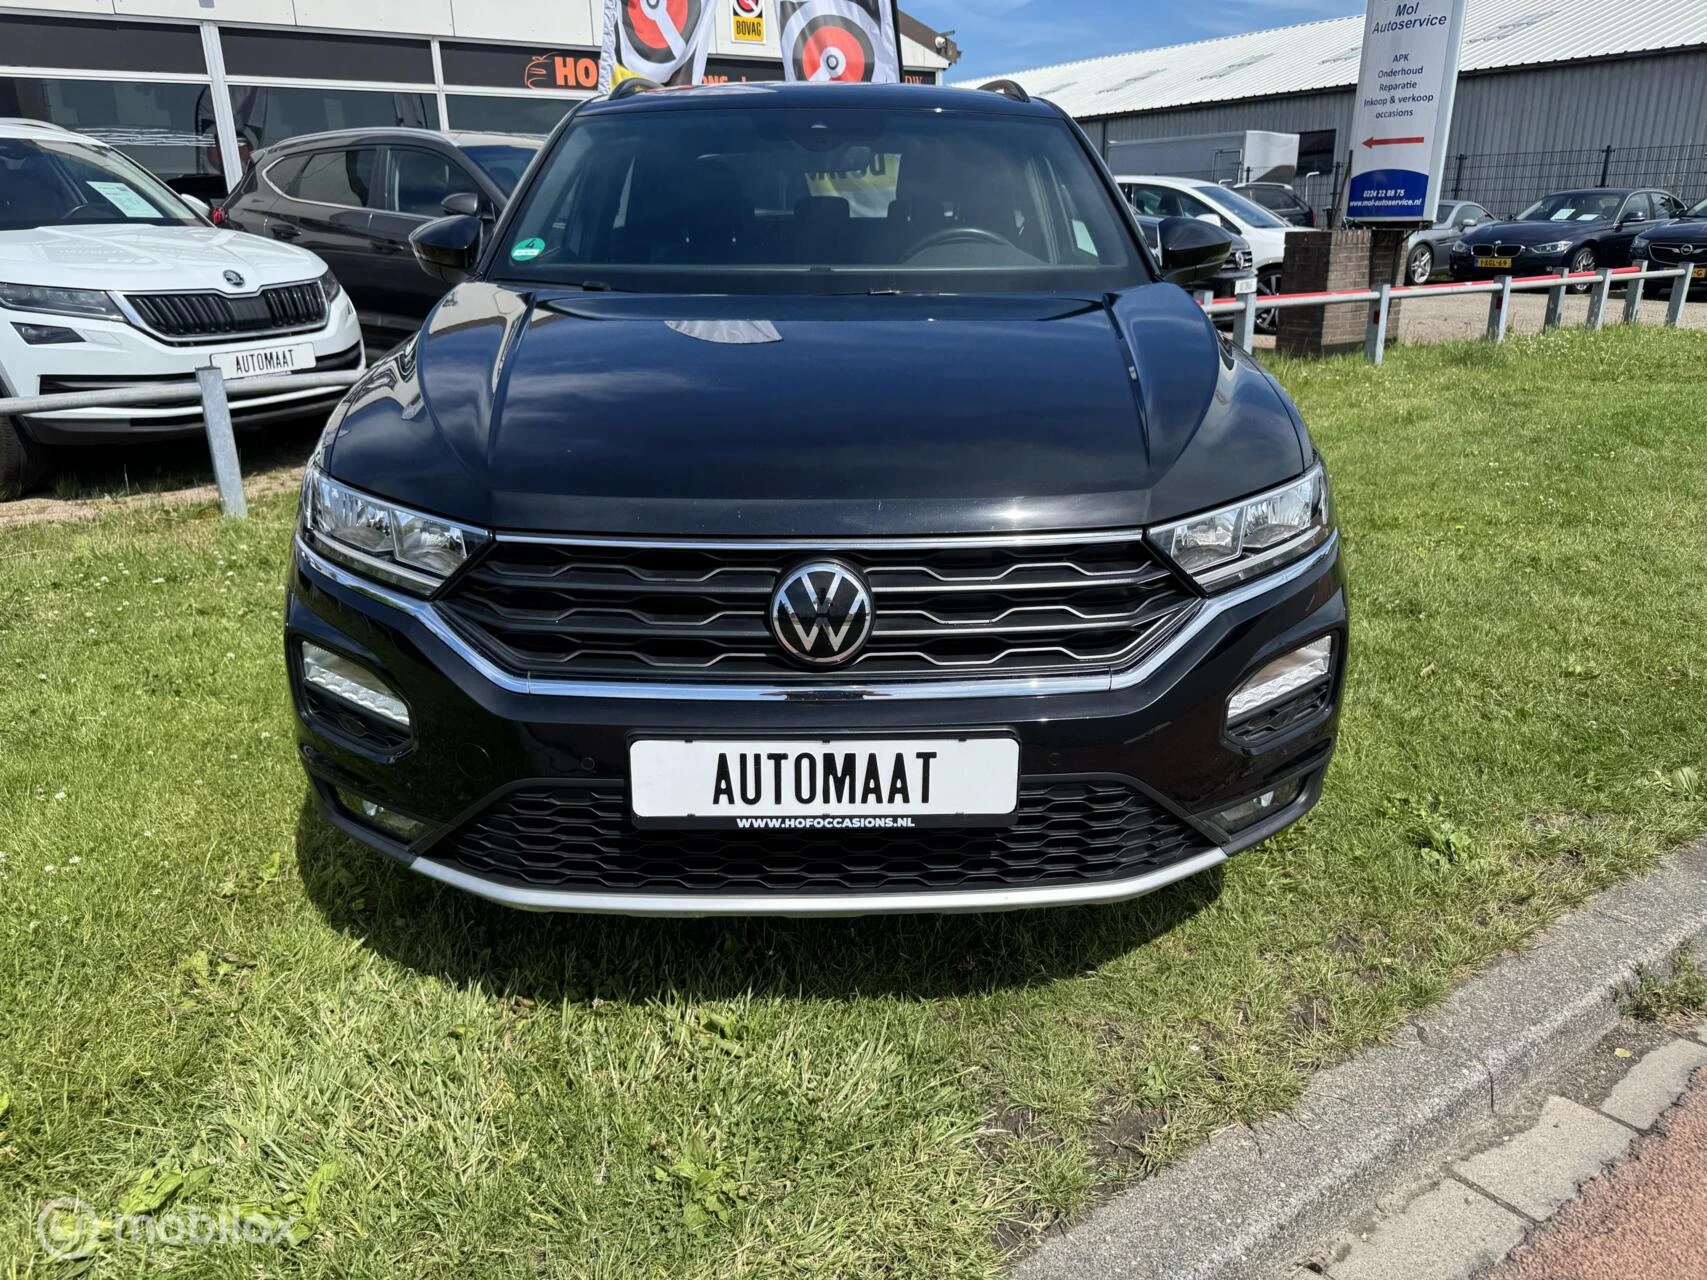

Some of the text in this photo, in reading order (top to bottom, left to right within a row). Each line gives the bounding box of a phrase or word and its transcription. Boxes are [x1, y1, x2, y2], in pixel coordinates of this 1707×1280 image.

[1395, 2, 1420, 17] Mol
[736, 20, 762, 37] BOVAG
[1372, 14, 1447, 34] Autoservice
[1392, 53, 1410, 63] APK
[554, 56, 598, 87] HO
[1377, 66, 1424, 79] Onderhoud
[1379, 80, 1418, 93] Reparatie
[1363, 94, 1434, 107] Inkoop & verkoop
[1375, 109, 1414, 119] occasions
[1363, 189, 1377, 198] 0224
[1378, 189, 1386, 197] 22
[1396, 189, 1405, 197] 75
[1349, 198, 1422, 207] www.mol-autoservice.nl
[235, 349, 295, 374] AUTOMAAT
[712, 752, 938, 806] AUTOMAAT
[735, 816, 915, 830] WWW.HOFOCCASIONS.NL
